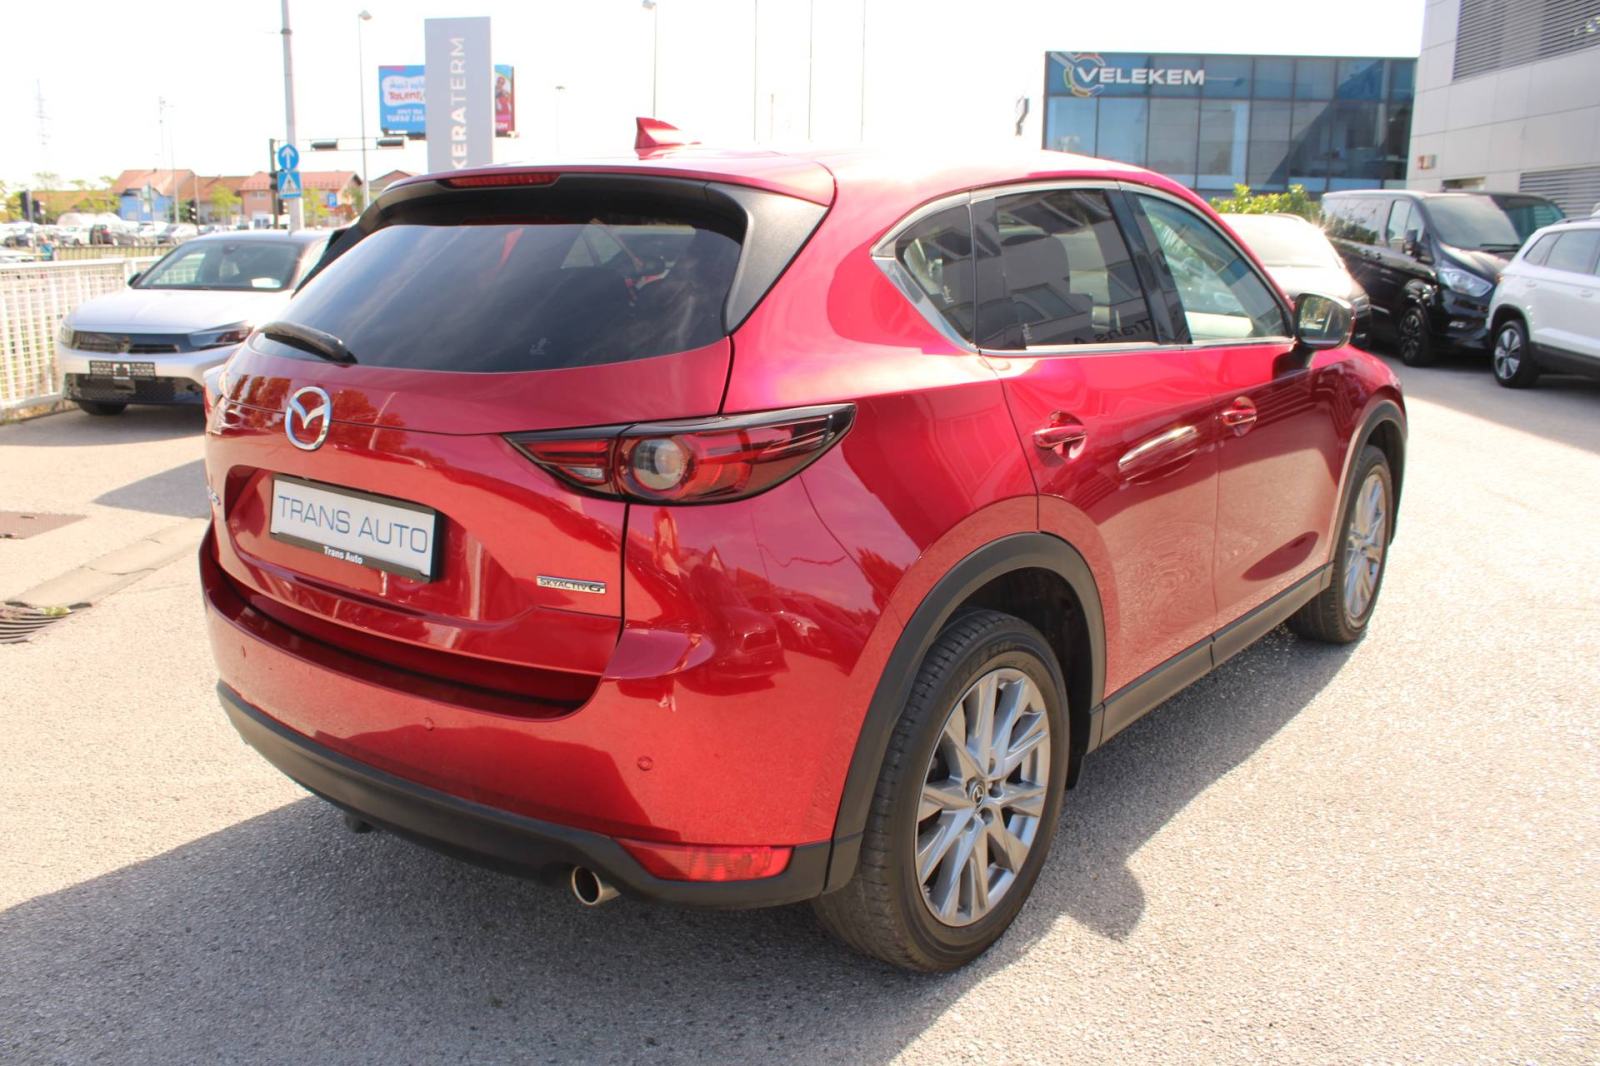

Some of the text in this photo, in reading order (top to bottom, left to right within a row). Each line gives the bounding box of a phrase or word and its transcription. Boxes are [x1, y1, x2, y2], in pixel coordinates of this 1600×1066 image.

[1077, 67, 1205, 86] VELEKEM
[278, 495, 428, 554] TRANS AUTO
[323, 545, 363, 565] Trans Auto
